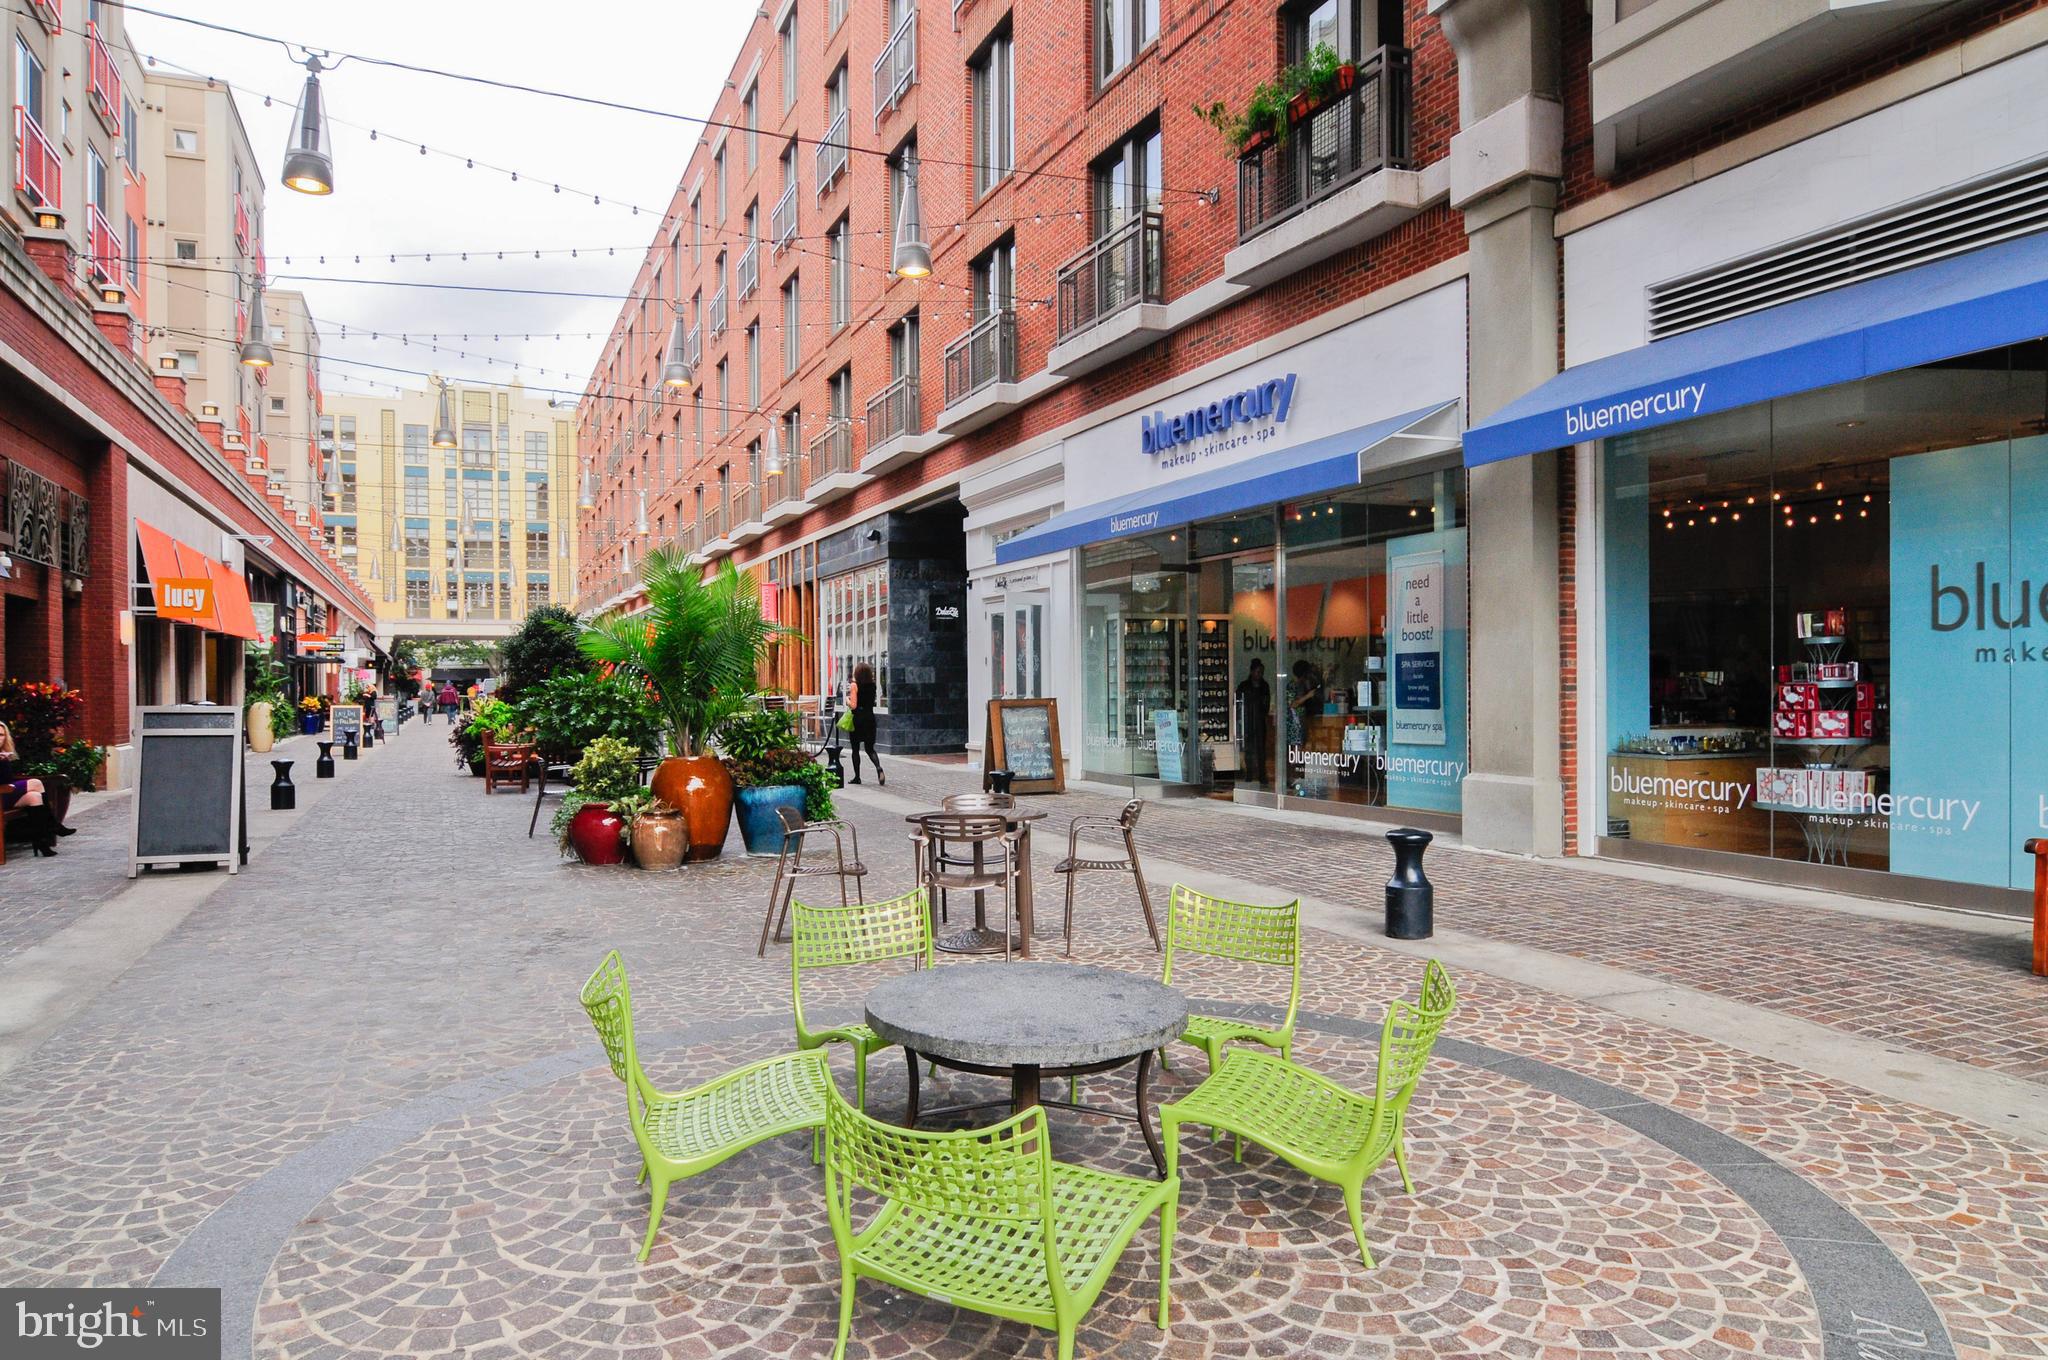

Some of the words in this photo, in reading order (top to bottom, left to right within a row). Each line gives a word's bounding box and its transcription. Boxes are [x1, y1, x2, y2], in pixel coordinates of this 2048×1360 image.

[1142, 374, 1297, 454] bluemercury
[1566, 383, 1706, 435] bluemercury
[1162, 451, 1196, 469] makeup
[1204, 434, 1248, 457] skincare
[1257, 426, 1275, 442] spa
[1110, 511, 1159, 533] bluemercury
[1406, 574, 1430, 590] need
[164, 584, 205, 611] lucy
[1415, 596, 1421, 607] a
[1931, 561, 2048, 632] blu
[1406, 610, 1429, 625] little
[1402, 626, 1434, 641] boost?
[1401, 660, 1411, 669] SPA
[1412, 659, 1435, 668] SERVICES
[1396, 720, 1431, 733] bluemercury
[1432, 723, 1443, 733] spa
[1288, 745, 1360, 773] bluemercury
[1376, 750, 1463, 782] bluemercury
[1316, 768, 1338, 776] skincare
[1611, 766, 1751, 809] bluemercury
[1624, 797, 1658, 808] makeup
[1665, 800, 1705, 811] skincare
[1713, 805, 1730, 815] spa
[1792, 777, 1980, 831] bluemercury
[1809, 814, 1853, 827] makeup
[1864, 818, 1918, 832] skincare
[1930, 826, 1952, 837] spa
